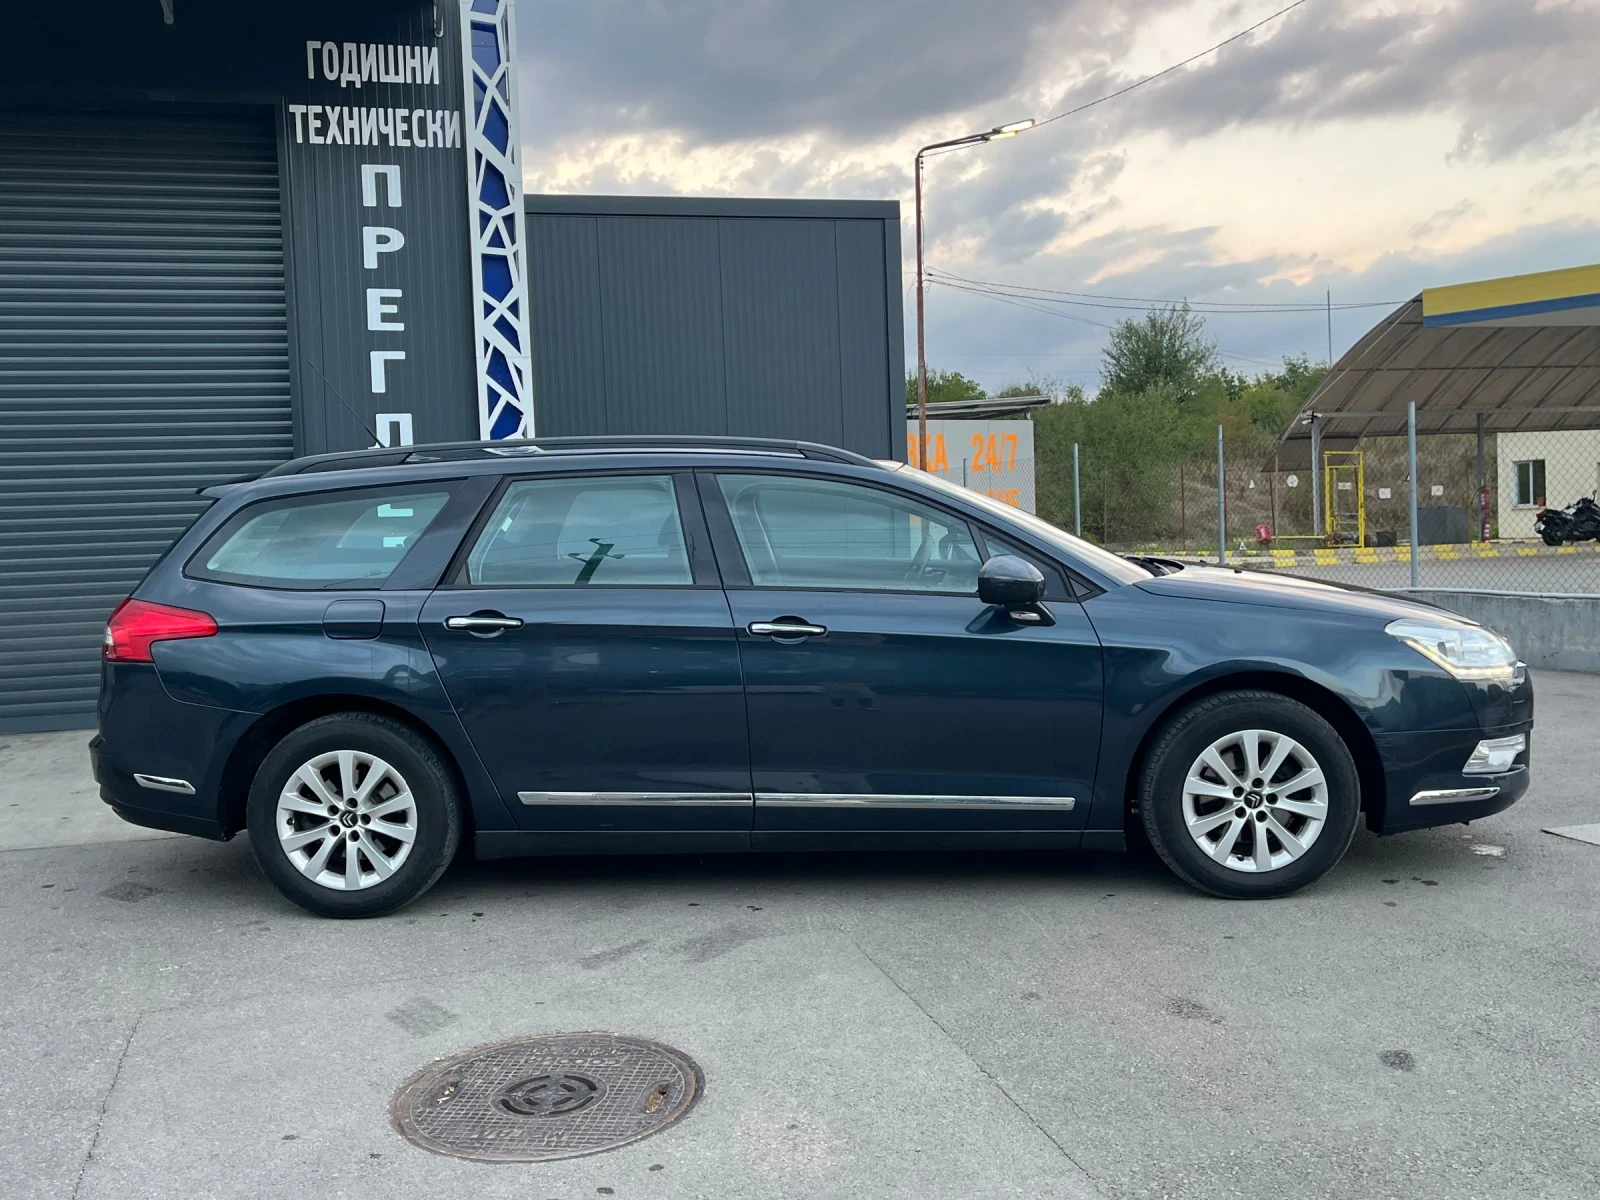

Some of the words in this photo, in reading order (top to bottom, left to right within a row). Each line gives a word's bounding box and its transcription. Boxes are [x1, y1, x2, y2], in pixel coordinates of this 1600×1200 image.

[306, 40, 440, 89] ГОДИШНИ
[288, 104, 461, 149] ТЕХНИЧЕСКИ
[361, 163, 416, 548] ПРЕГЛ
[970, 429, 1019, 476] 24/7
